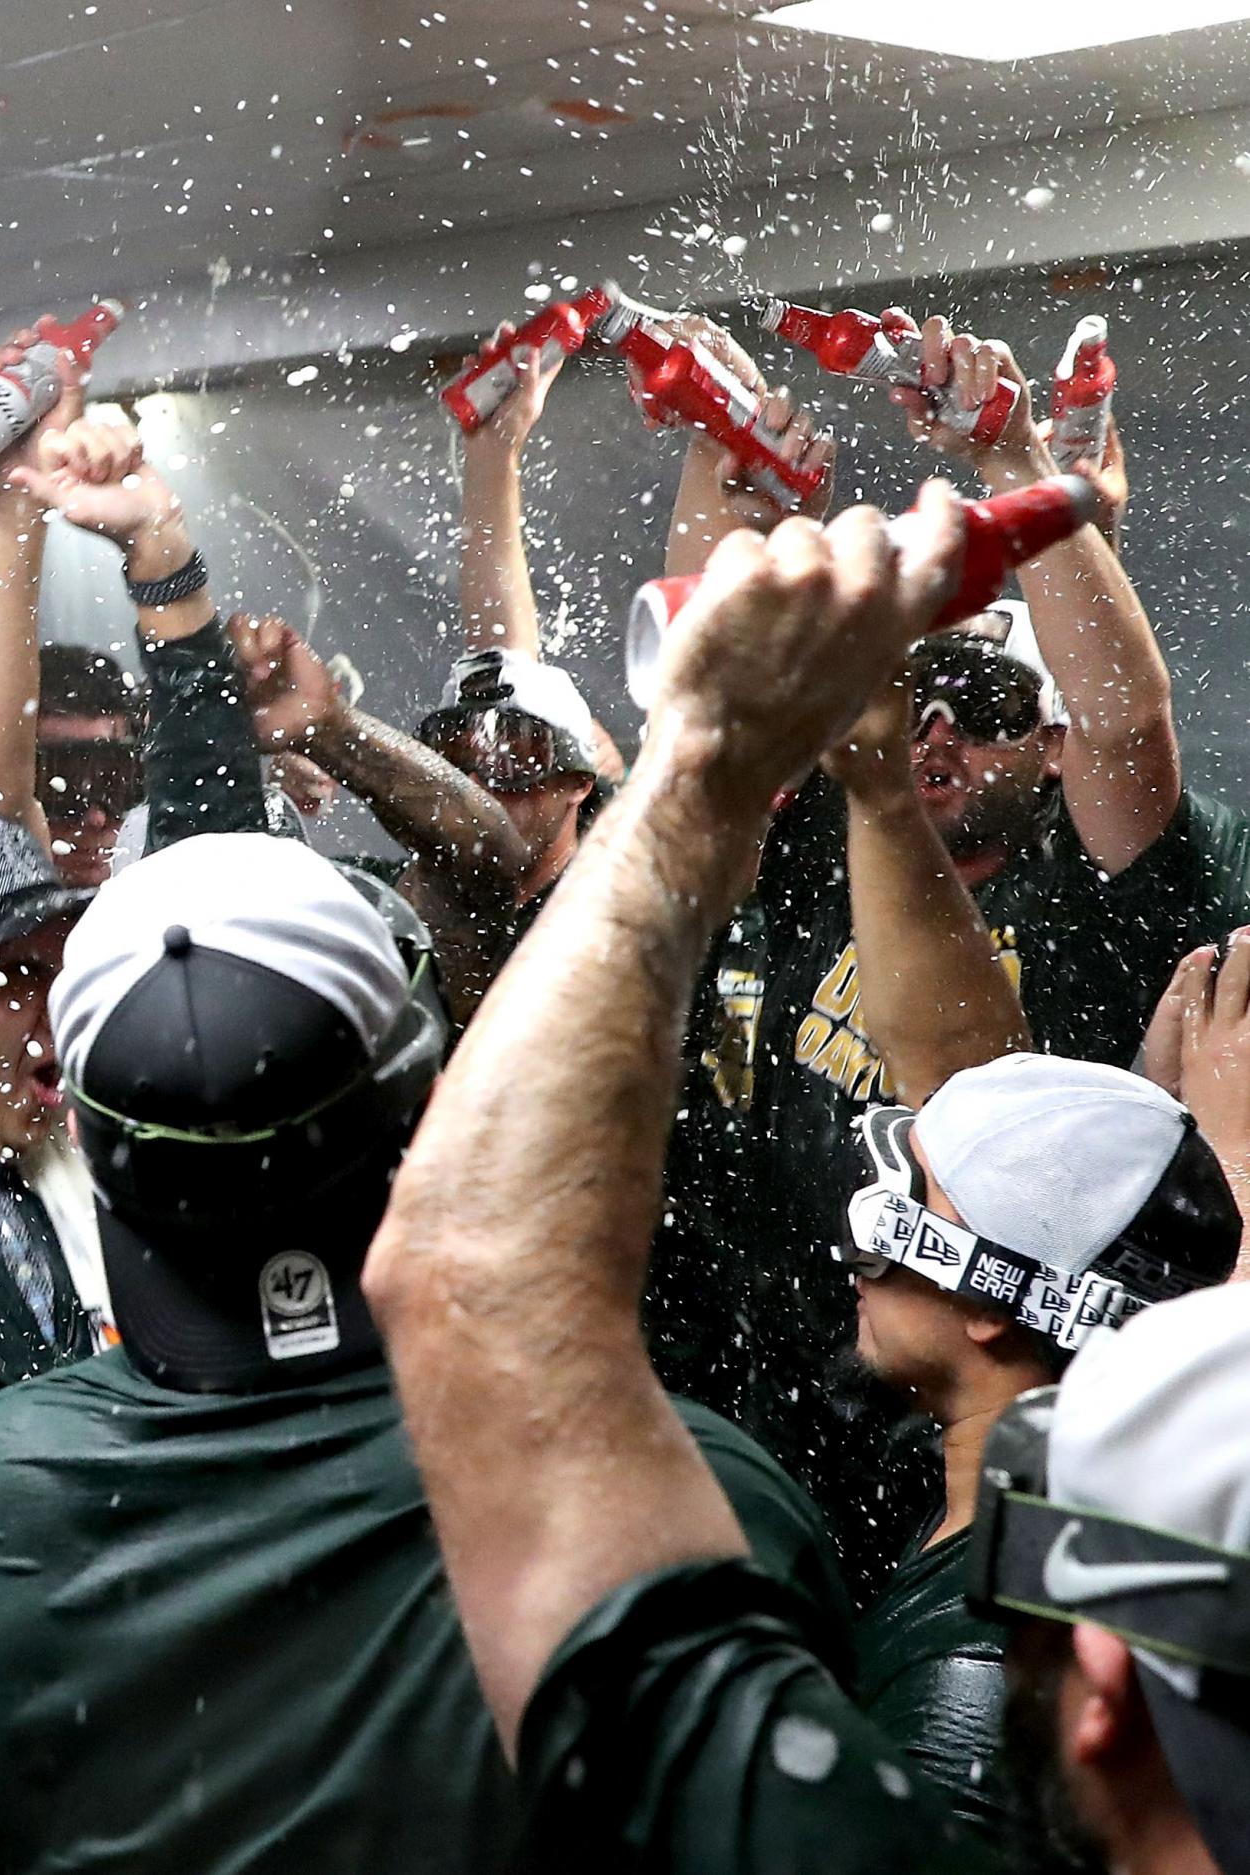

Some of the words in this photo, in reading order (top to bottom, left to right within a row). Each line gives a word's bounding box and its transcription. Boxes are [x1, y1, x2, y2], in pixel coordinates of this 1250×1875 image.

[272, 1265, 314, 1302] 47
[976, 1252, 1026, 1285] NEW
[968, 1269, 1019, 1303] ERA
